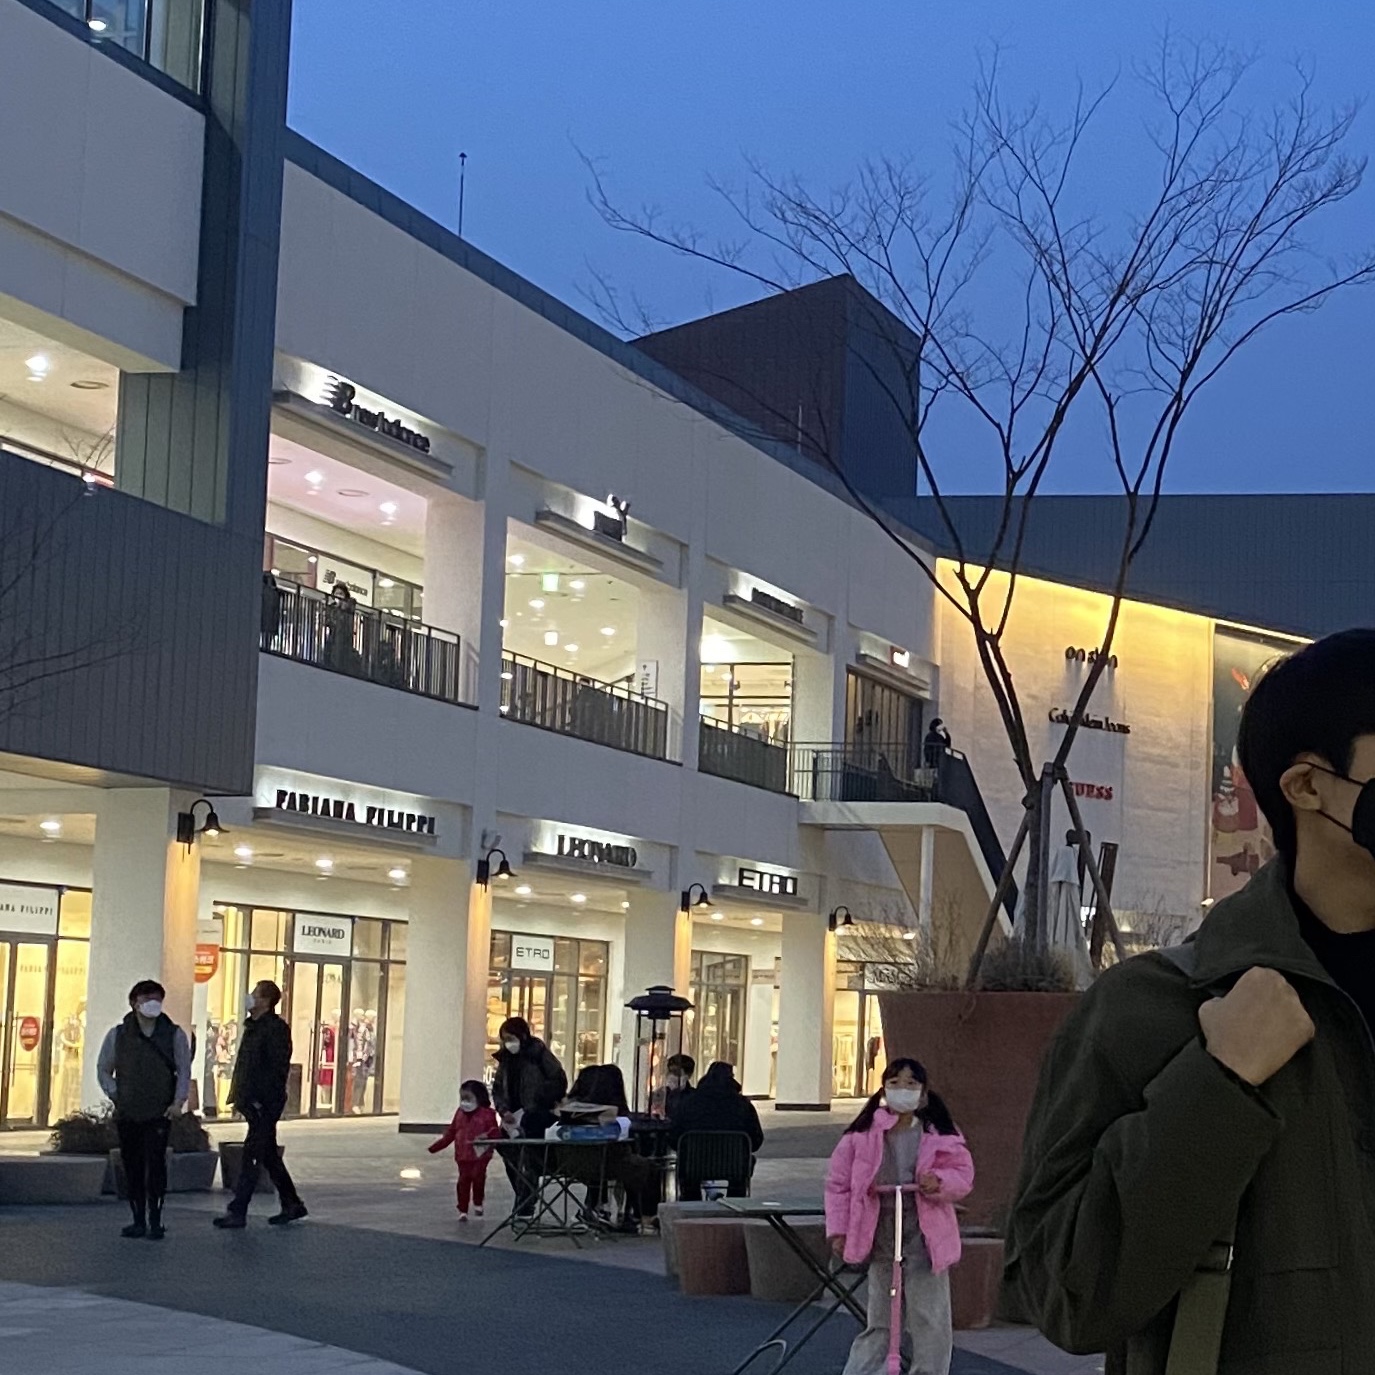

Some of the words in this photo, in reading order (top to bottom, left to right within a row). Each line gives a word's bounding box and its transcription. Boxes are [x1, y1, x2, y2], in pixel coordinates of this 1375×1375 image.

[1070, 782, 1114, 801] UESS
[276, 789, 355, 823] FABIANA
[366, 806, 435, 834] FILIPPI
[739, 867, 798, 896] ETRO
[301, 924, 345, 939] LEONARD
[516, 946, 550, 959] ETRO
